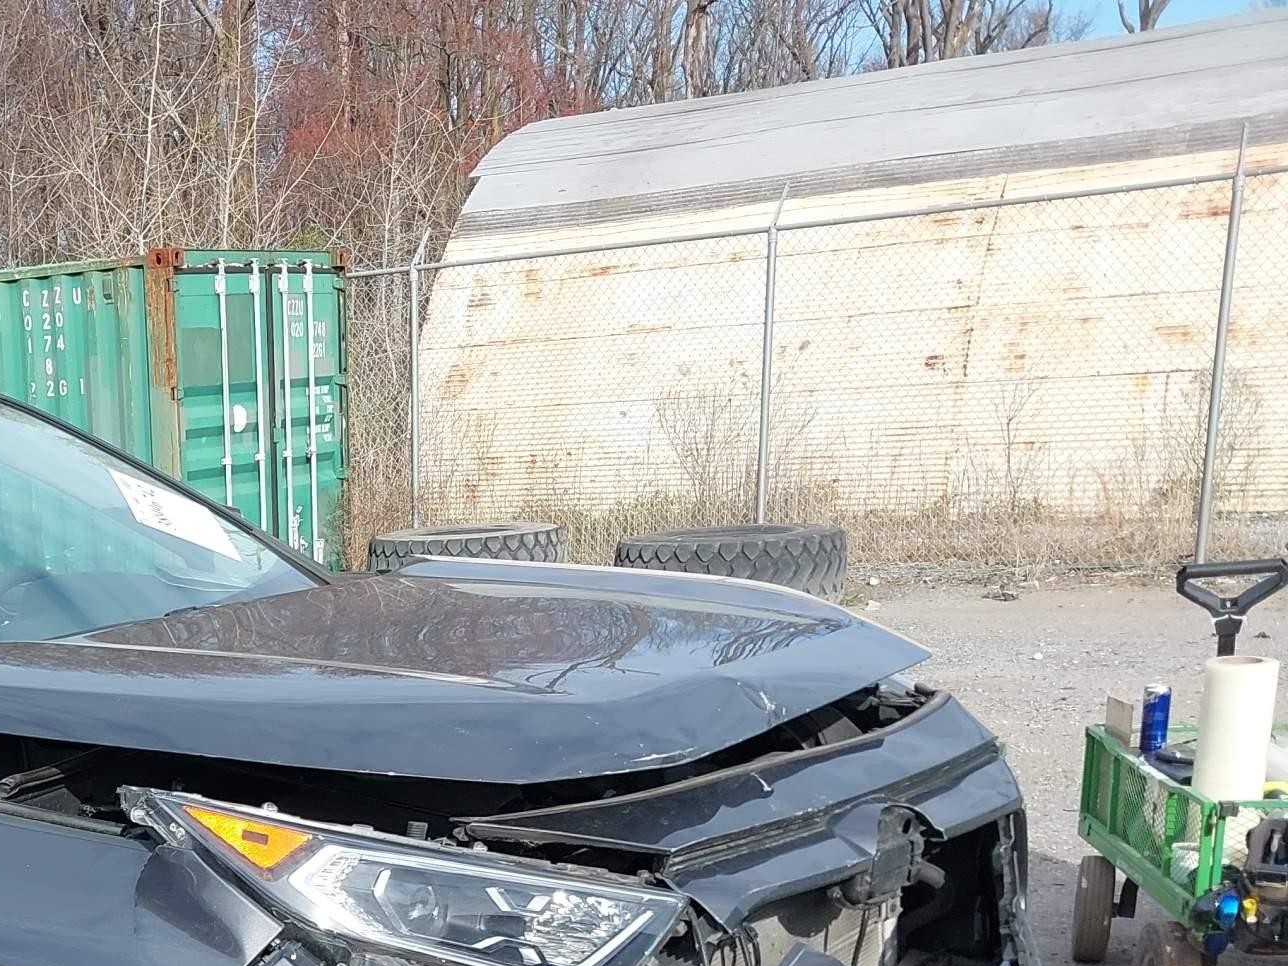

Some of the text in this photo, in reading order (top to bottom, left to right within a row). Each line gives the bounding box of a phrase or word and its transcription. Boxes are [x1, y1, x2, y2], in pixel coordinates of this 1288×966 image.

[24, 312, 64, 331] 020
[28, 334, 65, 354] 174
[45, 358, 54, 375] 8
